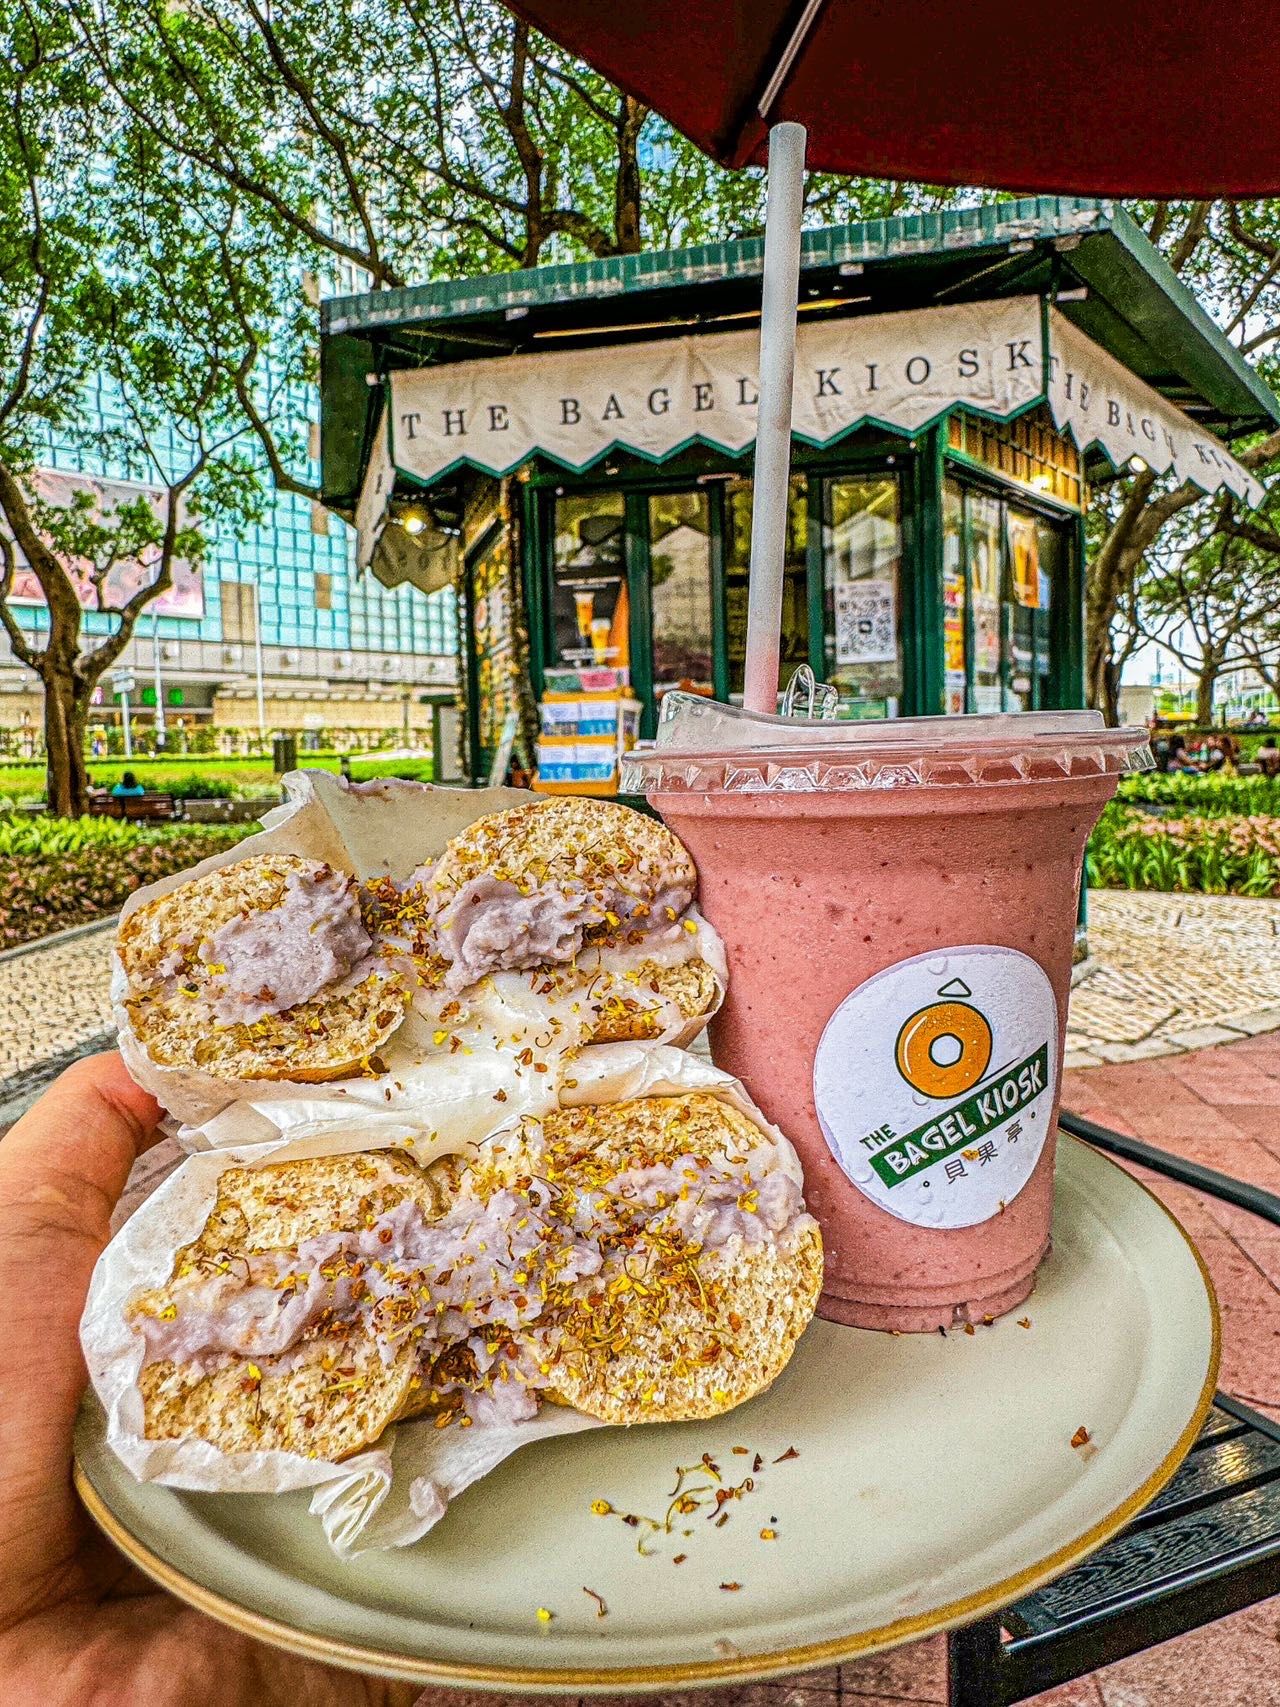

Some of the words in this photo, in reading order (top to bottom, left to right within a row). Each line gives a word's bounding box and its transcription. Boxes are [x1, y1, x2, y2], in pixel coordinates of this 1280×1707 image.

[401, 404, 510, 440] THE
[559, 376, 759, 426] BAGEL
[815, 340, 1034, 399] KIOSK
[859, 1123, 898, 1152] THE
[883, 1111, 977, 1176] BAGEL
[975, 1059, 1044, 1126] KIOSK
[944, 1119, 1024, 1185] 貝果亭
